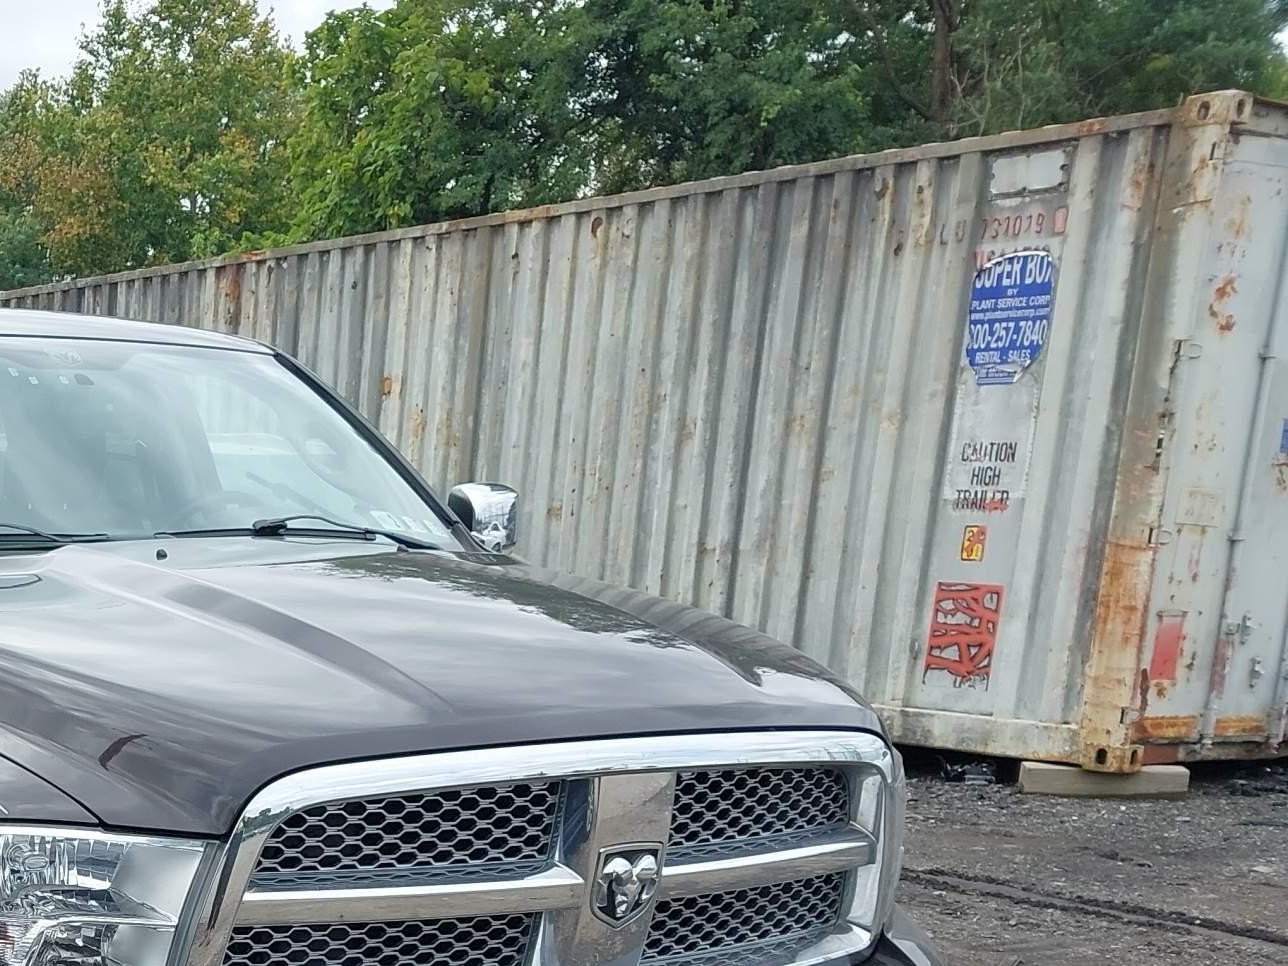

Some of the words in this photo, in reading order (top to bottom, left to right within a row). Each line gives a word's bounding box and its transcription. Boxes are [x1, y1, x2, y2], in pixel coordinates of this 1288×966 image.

[1007, 288, 1020, 296] BY
[970, 298, 996, 311] PLANT
[997, 296, 1028, 309] SERVICE
[1007, 349, 1032, 362] SALES
[961, 441, 1018, 462] CAUTION
[970, 465, 1001, 486] HIGH
